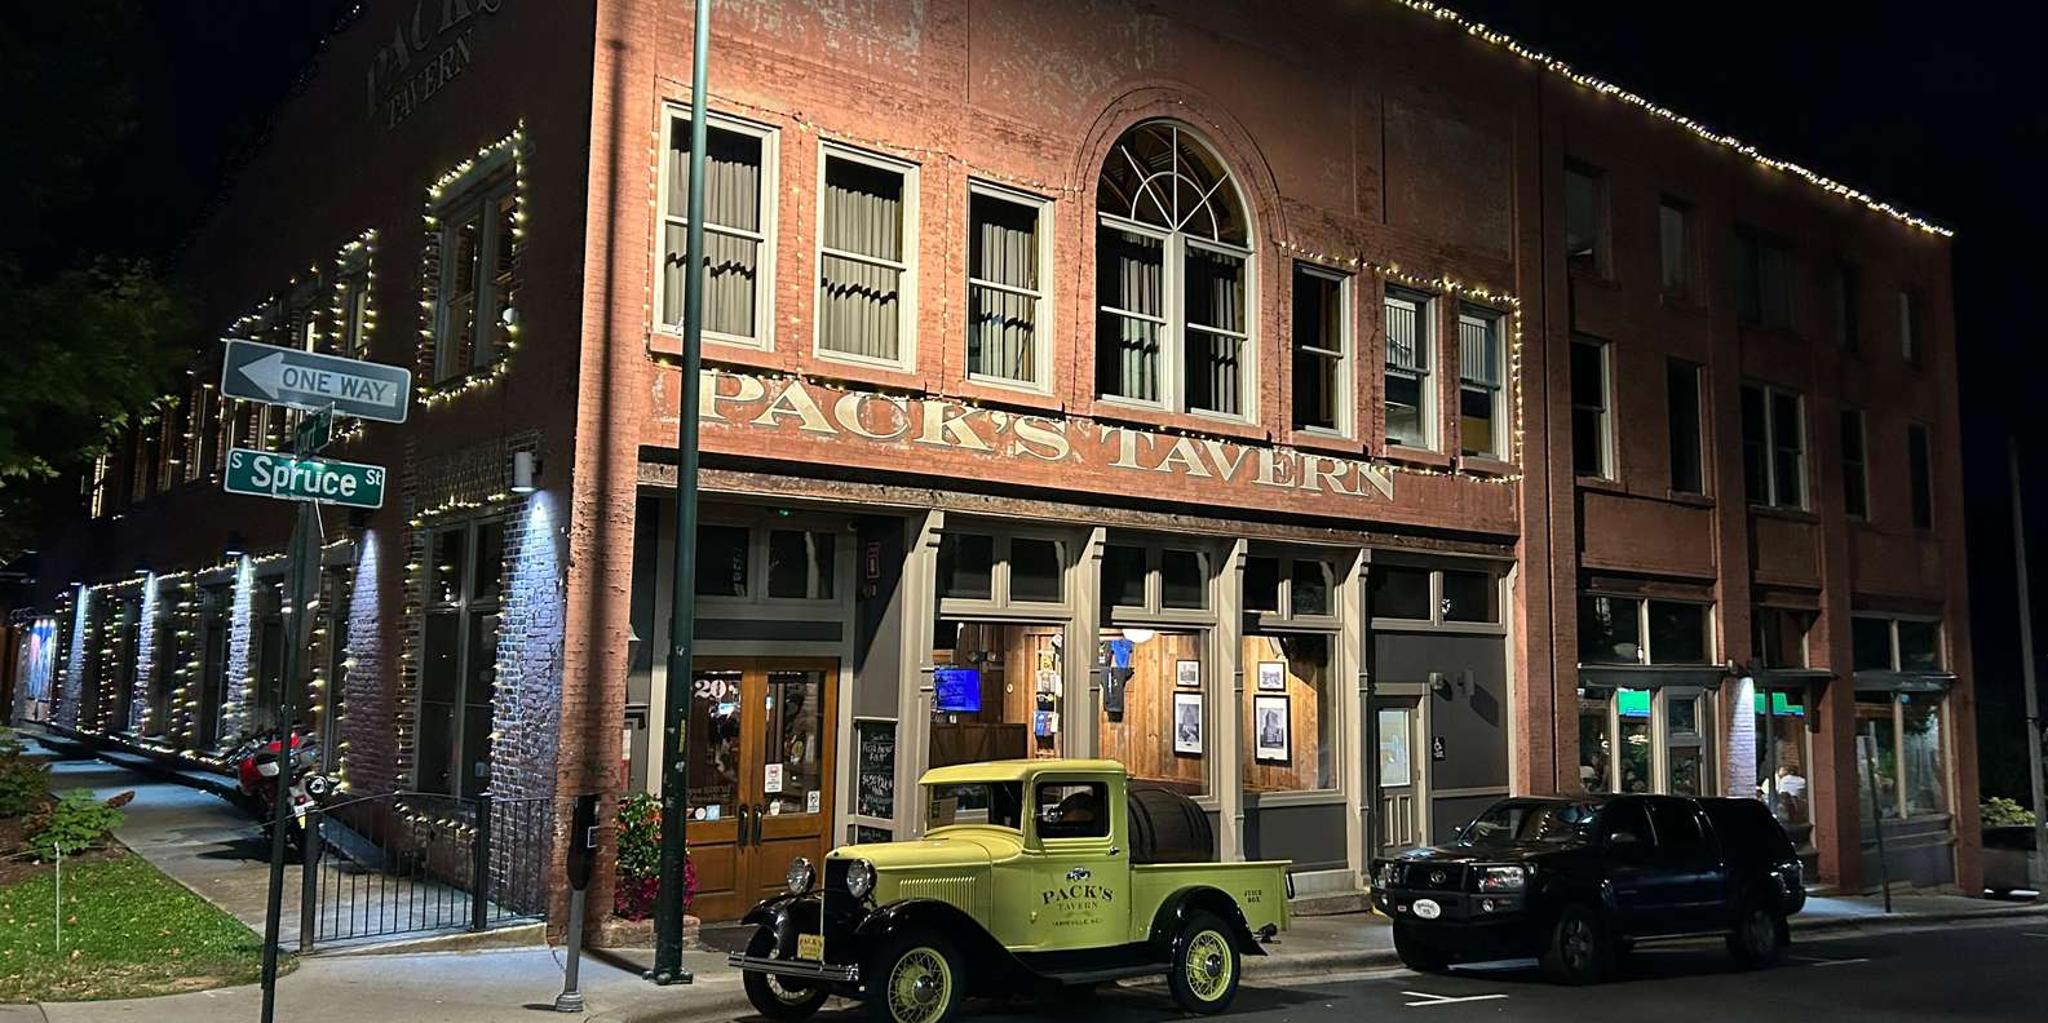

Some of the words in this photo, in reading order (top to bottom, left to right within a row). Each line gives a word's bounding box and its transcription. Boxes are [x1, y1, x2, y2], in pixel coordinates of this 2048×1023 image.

[282, 367, 331, 394] ONE
[340, 376, 389, 402] WAY
[697, 369, 1070, 462] PACK'S
[1100, 425, 1399, 502] TAVERN
[231, 452, 243, 469] S
[251, 455, 357, 497] Spruce
[365, 469, 382, 486] St
[1042, 884, 1114, 905] PACK'S
[1056, 901, 1098, 911] TAVERN
